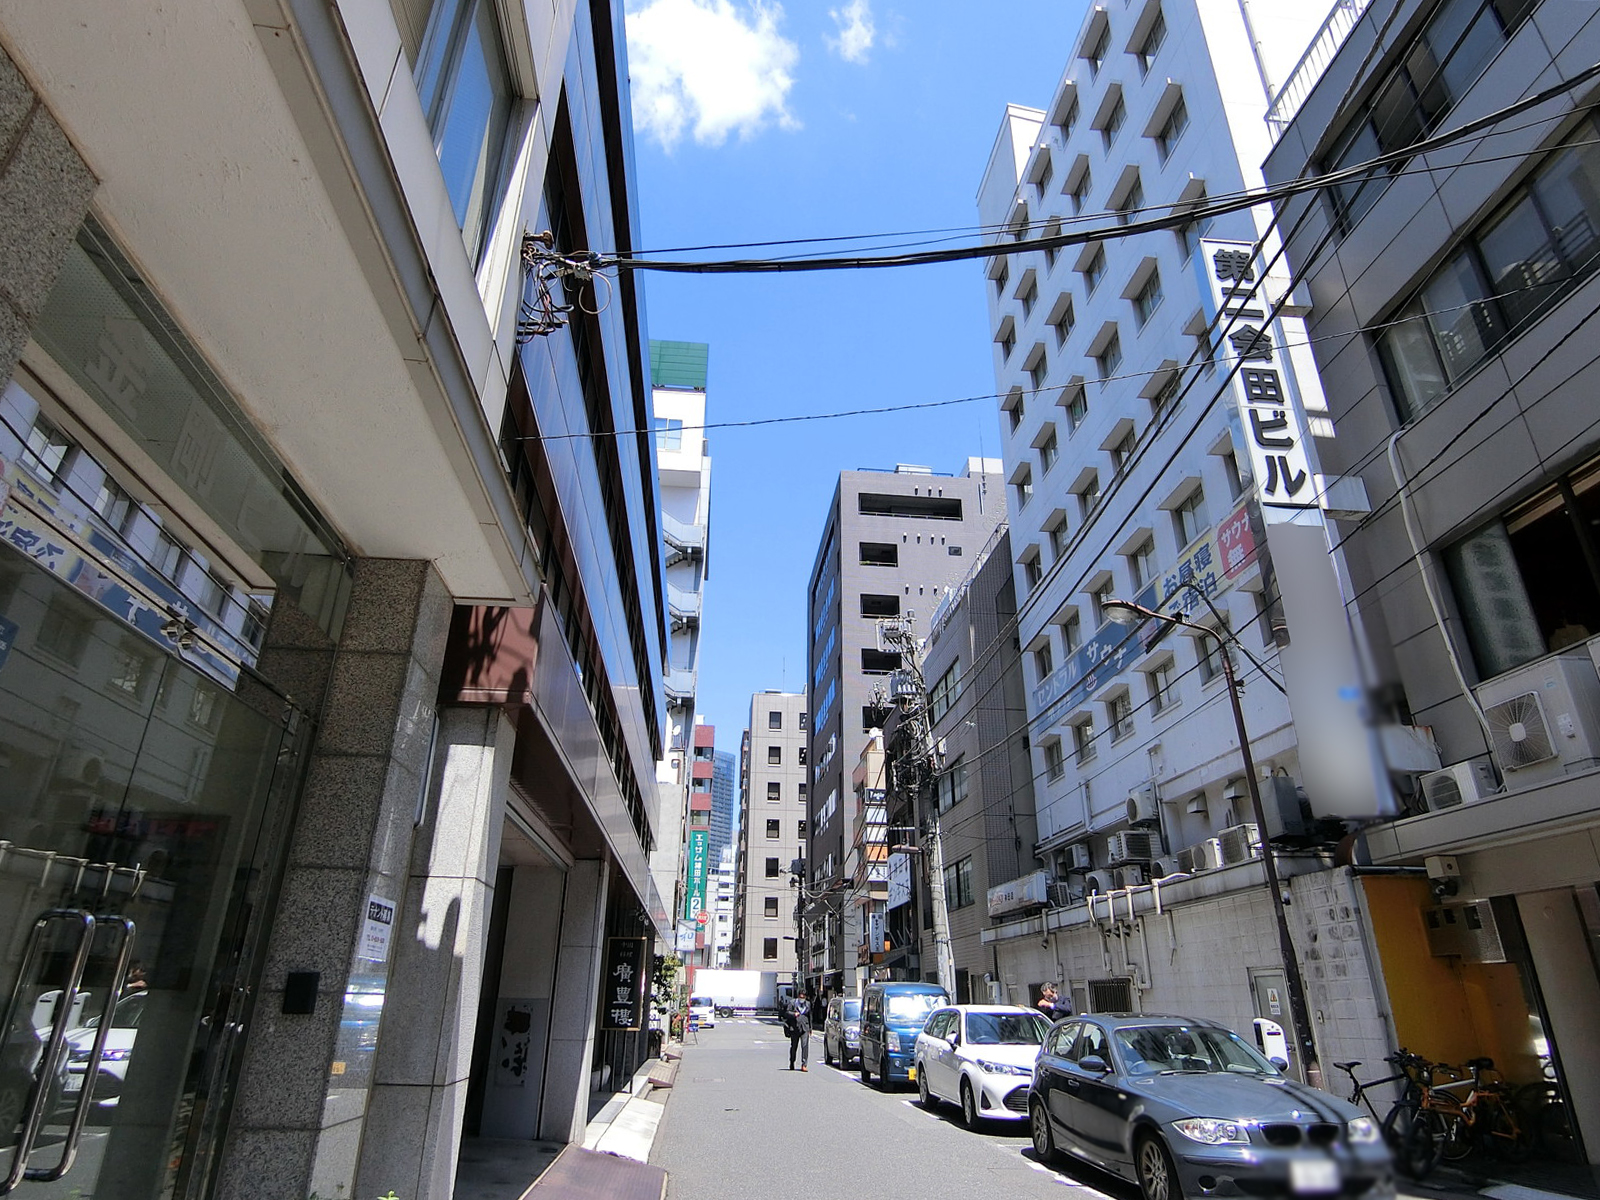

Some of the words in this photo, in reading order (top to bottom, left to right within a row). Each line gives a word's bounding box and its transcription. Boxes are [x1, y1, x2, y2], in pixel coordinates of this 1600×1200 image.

[1221, 512, 1249, 547] サウナ
[1086, 641, 1127, 669] サウナ
